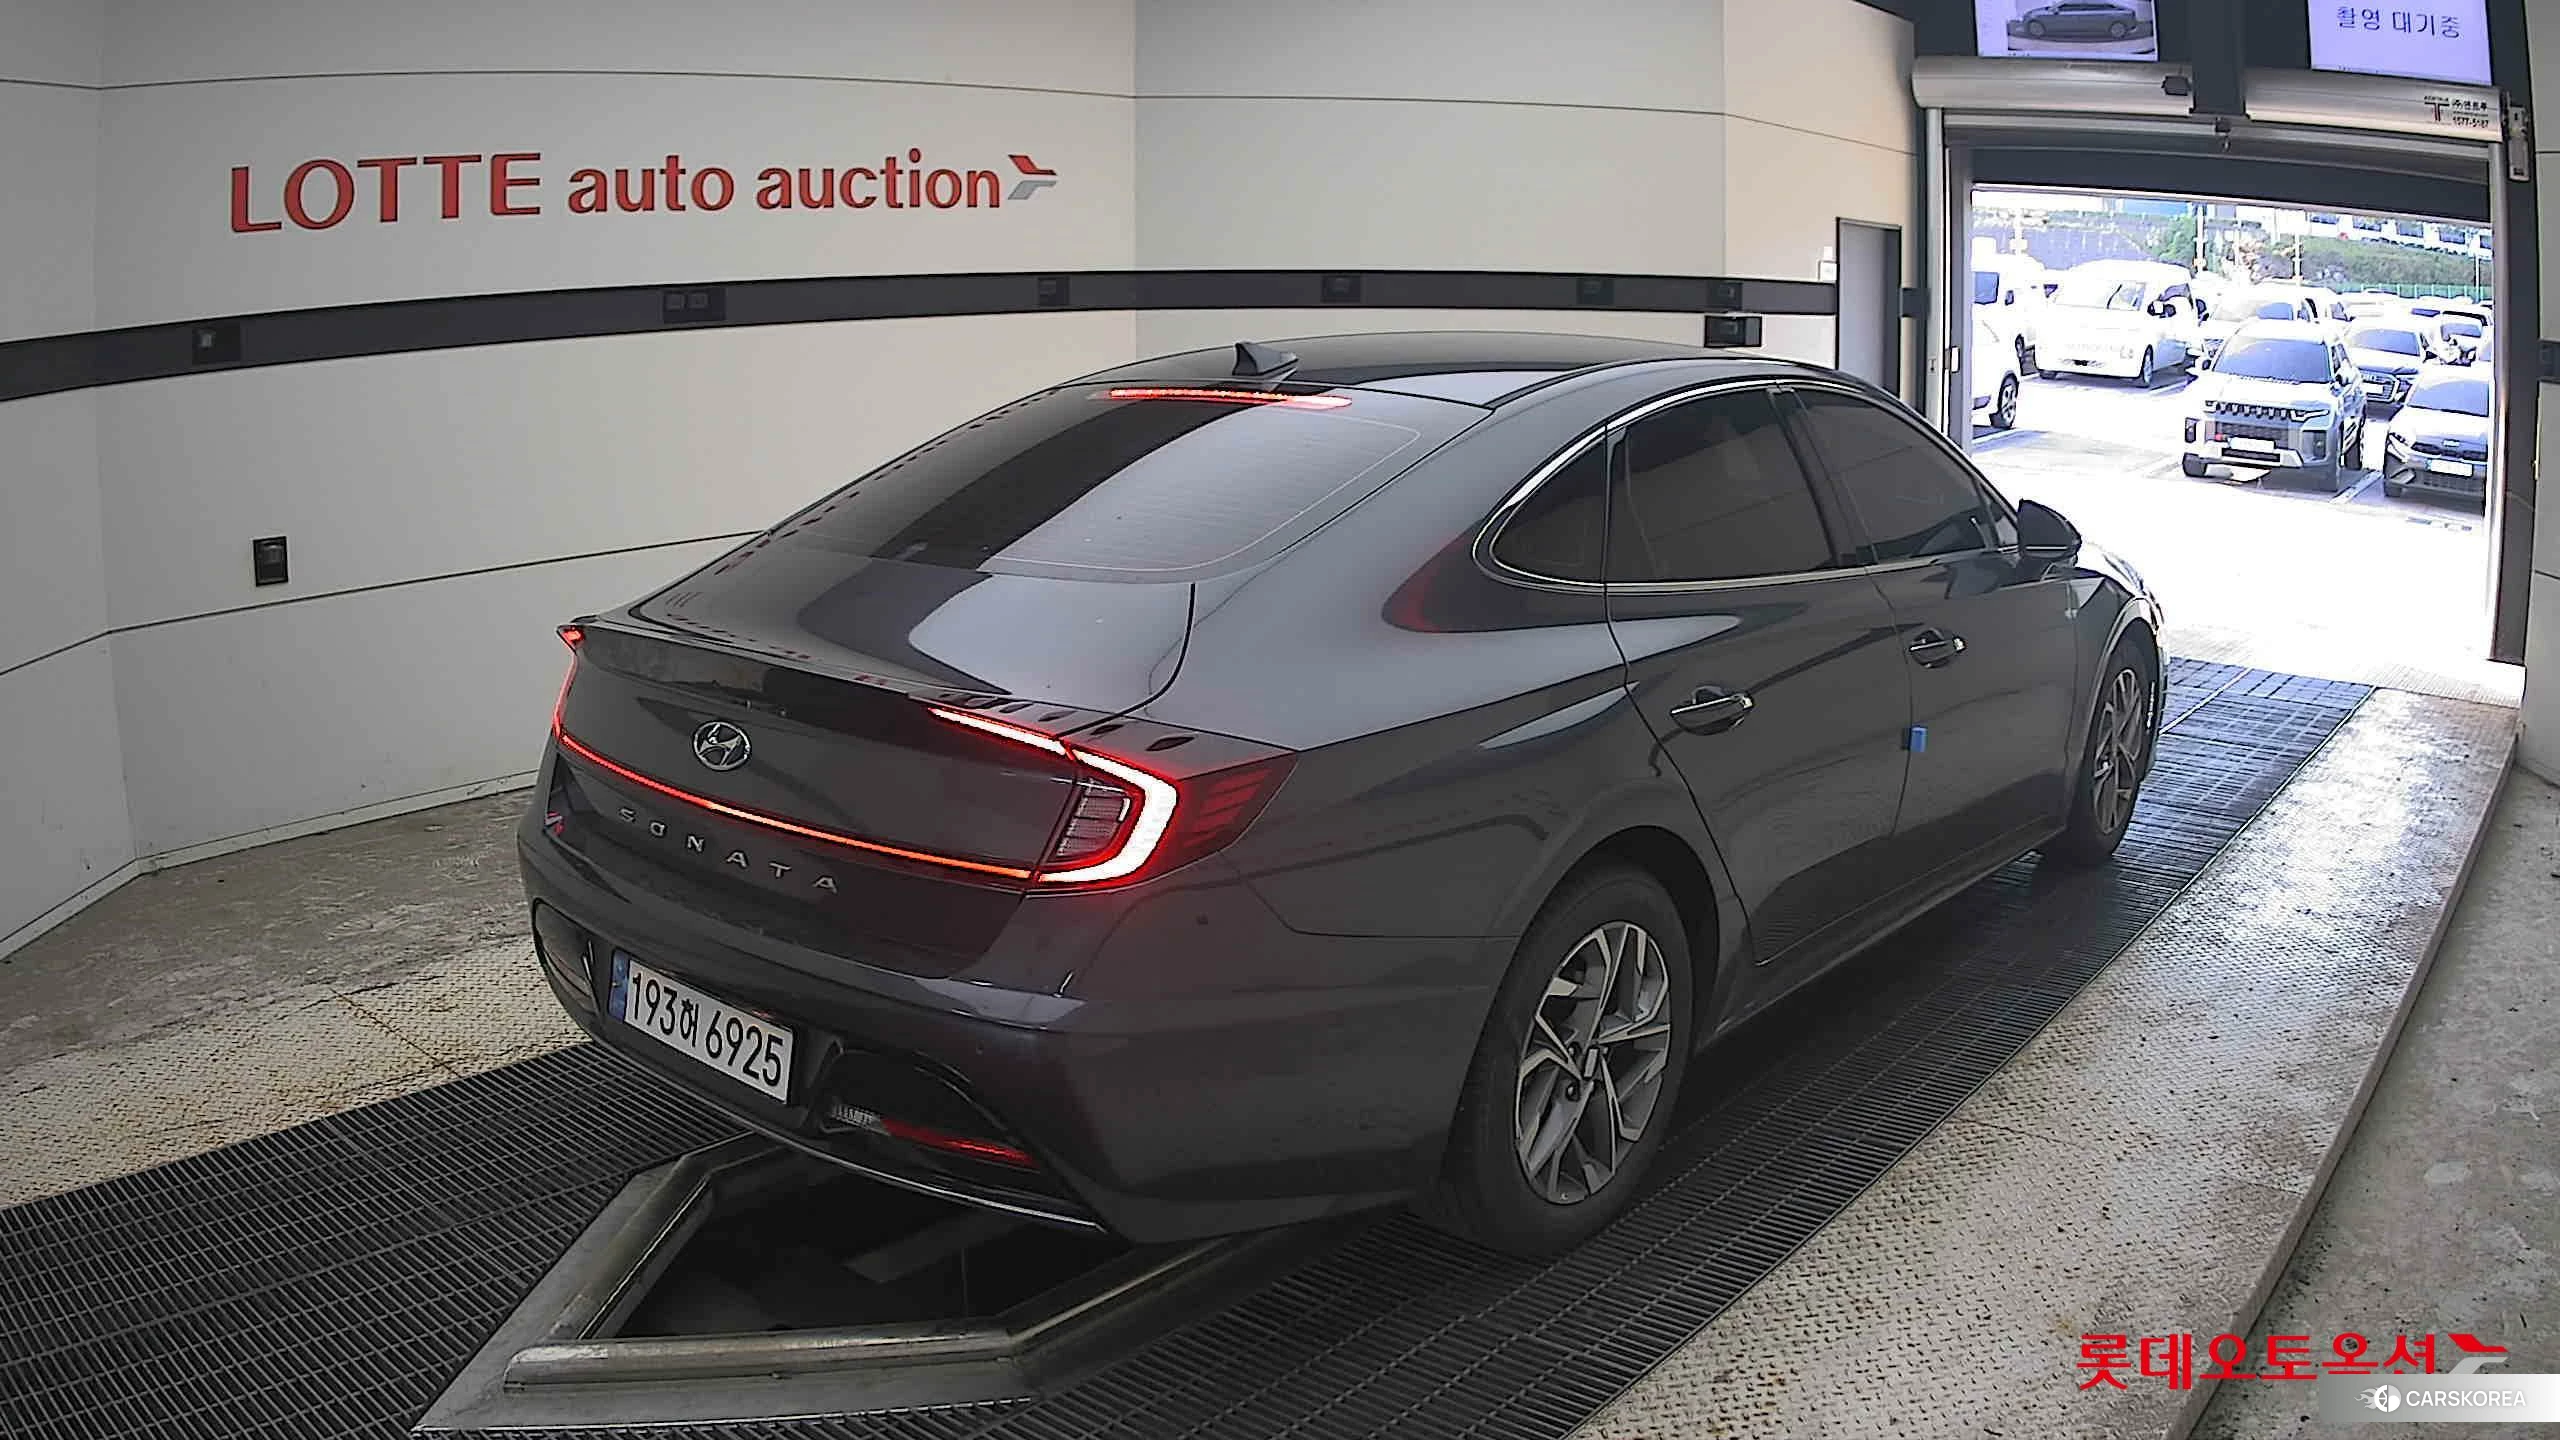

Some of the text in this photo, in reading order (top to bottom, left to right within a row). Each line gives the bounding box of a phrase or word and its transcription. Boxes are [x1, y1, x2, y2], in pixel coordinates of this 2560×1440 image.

[2392, 11, 2460, 39] 대기중
[230, 147, 1001, 233] LOTTE auto auction
[618, 807, 839, 895] SONATA
